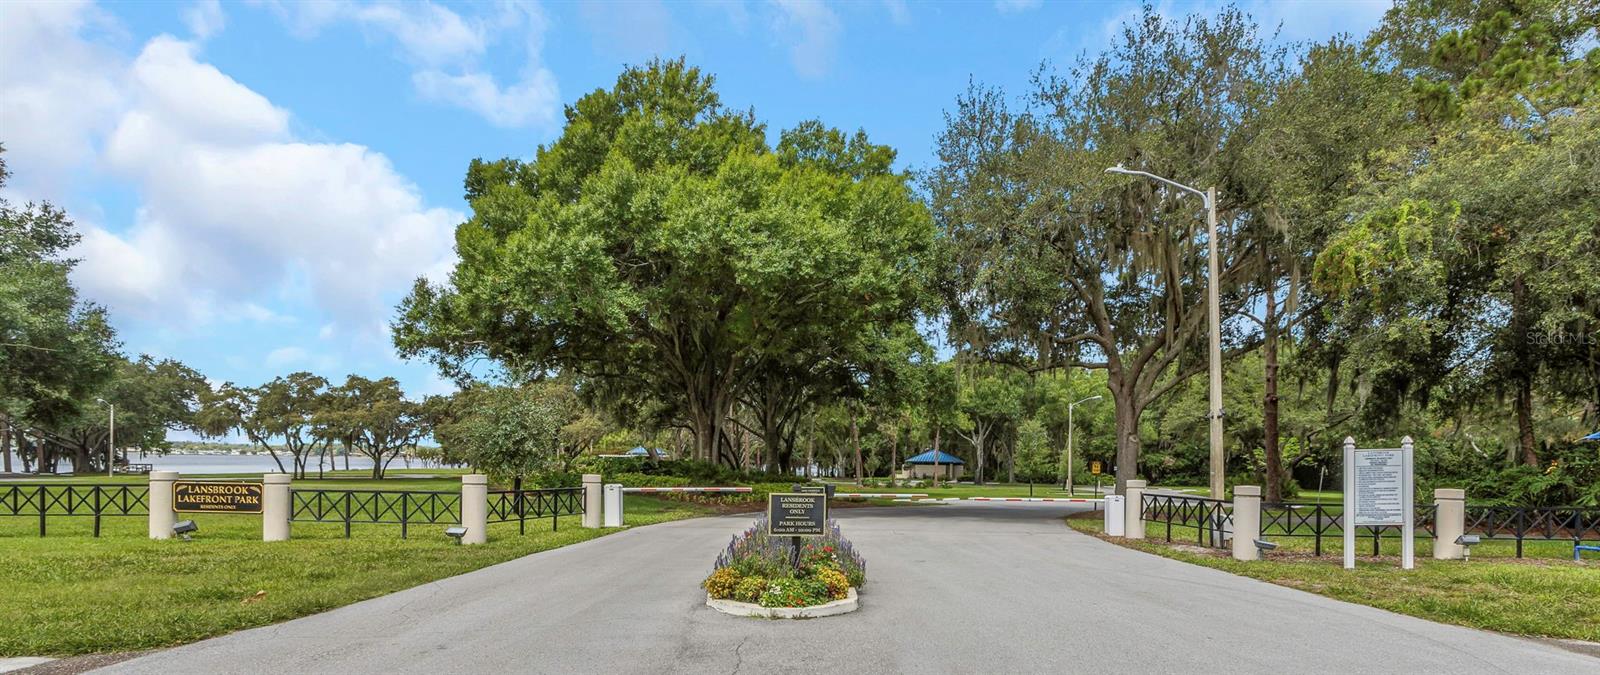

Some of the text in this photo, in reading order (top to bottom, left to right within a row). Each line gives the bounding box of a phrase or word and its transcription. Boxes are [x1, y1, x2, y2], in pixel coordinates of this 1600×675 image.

[188, 485, 249, 494] LANSBROOK
[177, 495, 259, 504] LAKEFRONT PARK
